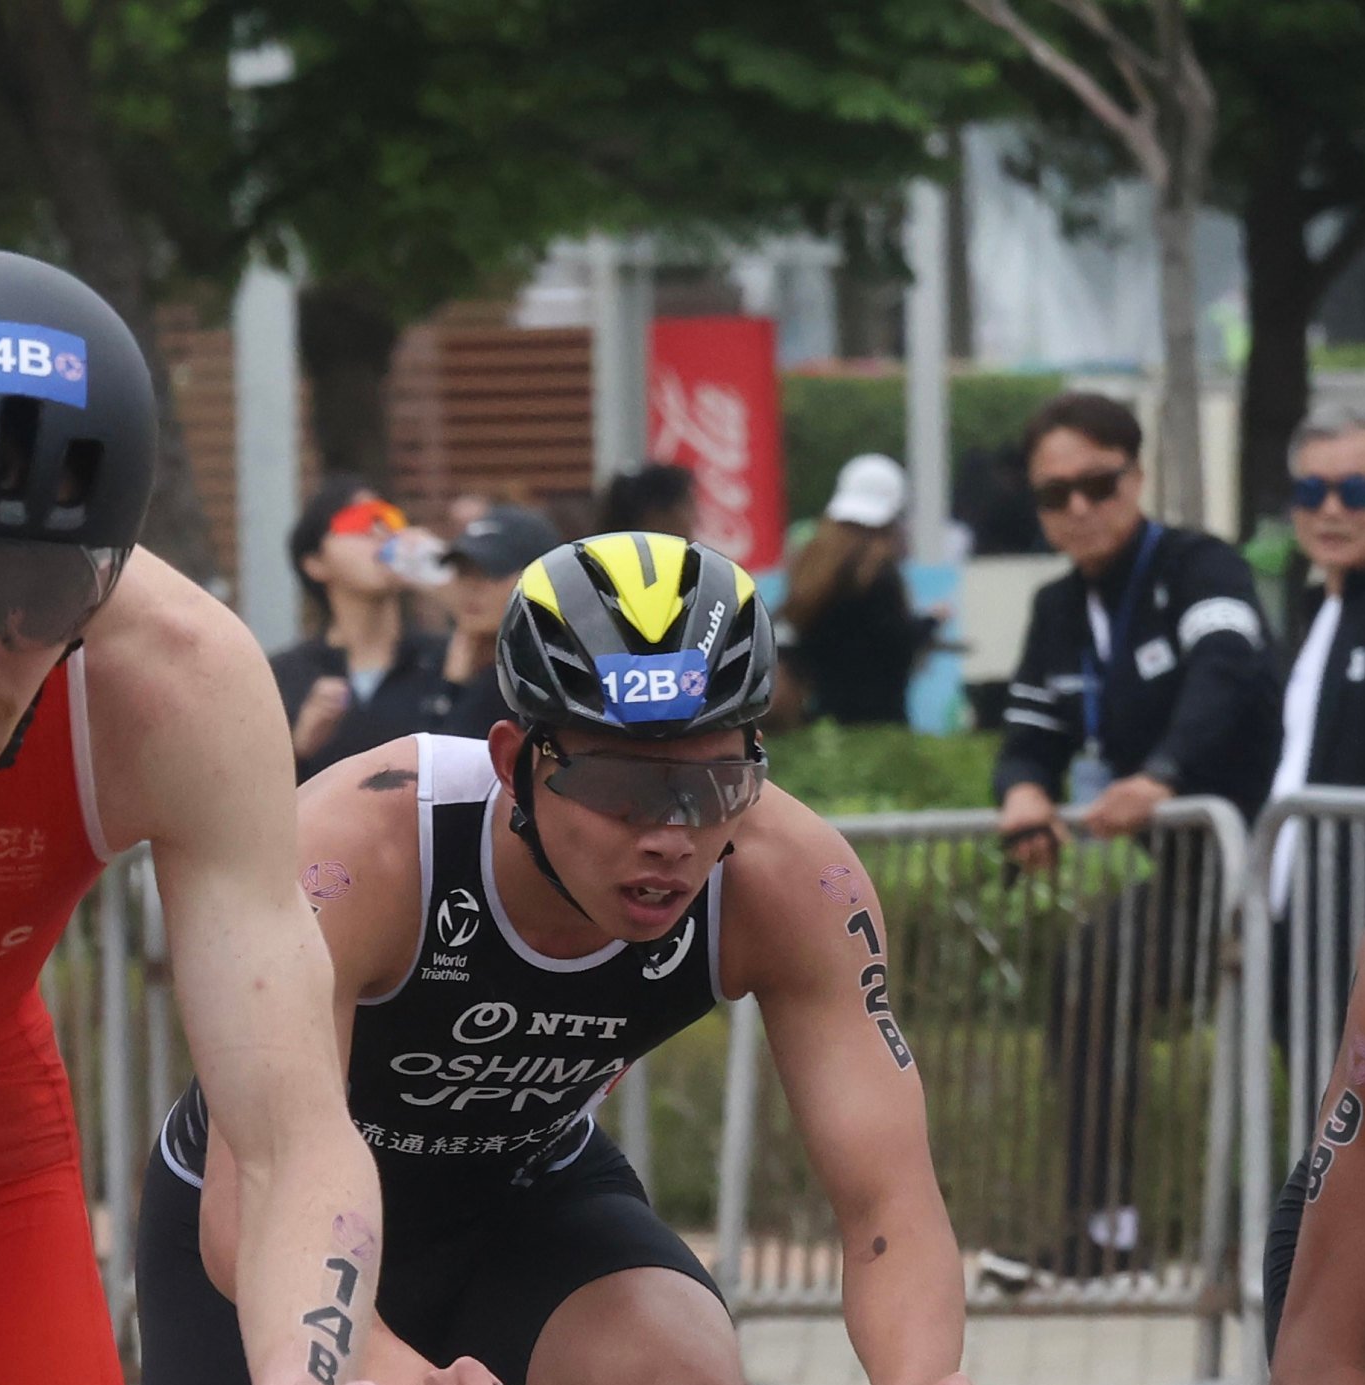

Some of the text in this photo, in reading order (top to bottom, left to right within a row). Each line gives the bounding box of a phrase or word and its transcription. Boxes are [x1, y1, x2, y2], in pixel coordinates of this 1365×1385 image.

[602, 669, 678, 703] 12B
[421, 967, 471, 982] Triathlon
[433, 952, 468, 968] World
[846, 908, 914, 1071] 12B
[526, 1012, 627, 1039] NTT
[390, 1052, 625, 1083] OSHIMA
[400, 1086, 578, 1112] JPN
[1306, 1089, 1363, 1203] 9B
